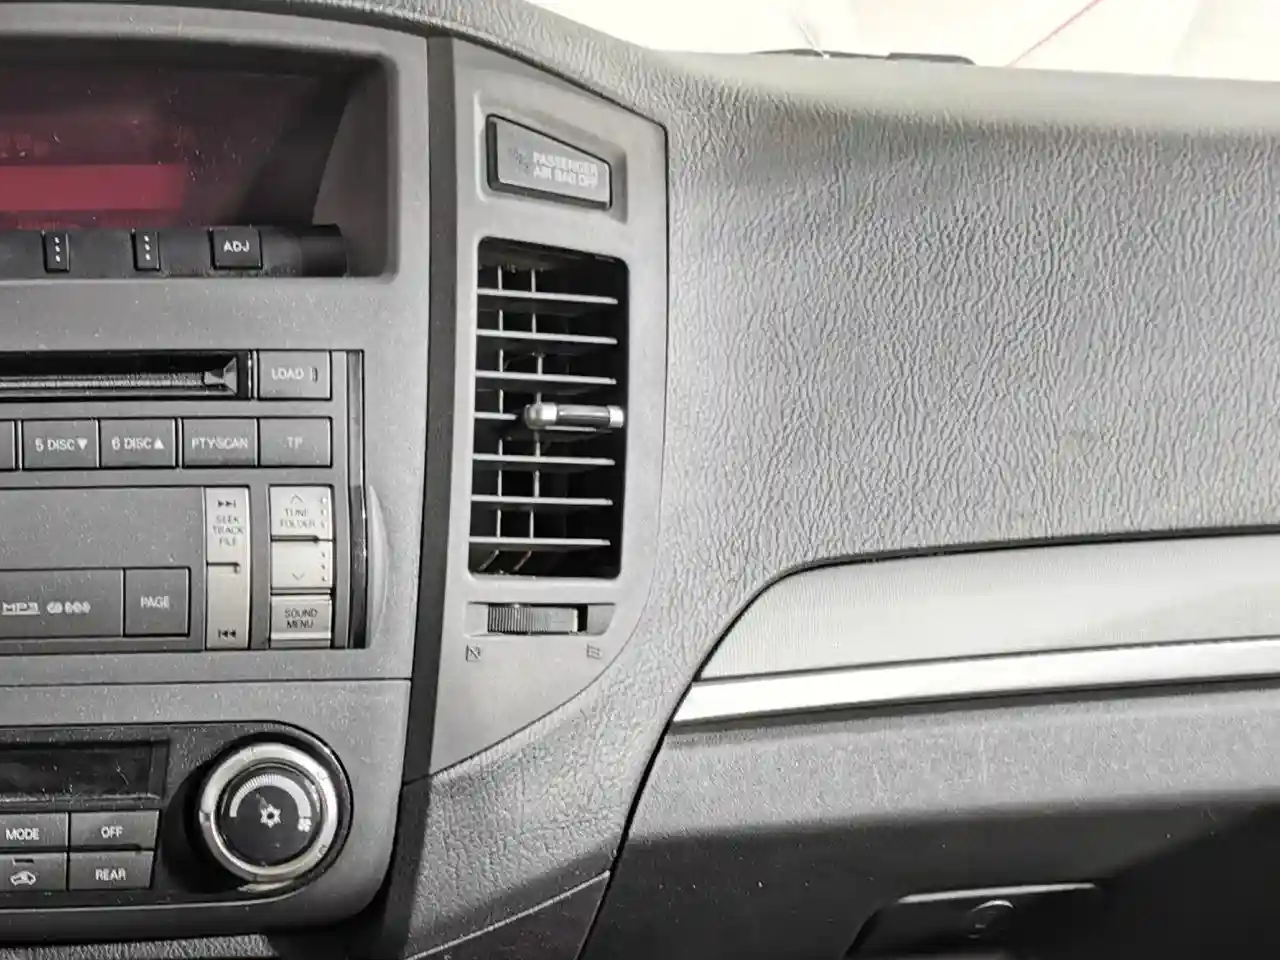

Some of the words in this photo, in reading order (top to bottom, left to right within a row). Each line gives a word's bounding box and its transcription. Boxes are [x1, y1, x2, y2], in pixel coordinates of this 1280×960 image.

[223, 239, 250, 253] ADJ
[271, 367, 304, 380] LOAD
[35, 438, 44, 451] 5
[48, 438, 76, 451] DISC
[111, 437, 120, 450] 6
[124, 436, 152, 450] DISC
[141, 596, 169, 609] PAGE
[284, 608, 318, 618] SOUND
[286, 620, 314, 629] MENU
[5, 828, 40, 841] MODE
[100, 826, 123, 839] OFF
[95, 867, 127, 881] REAR
